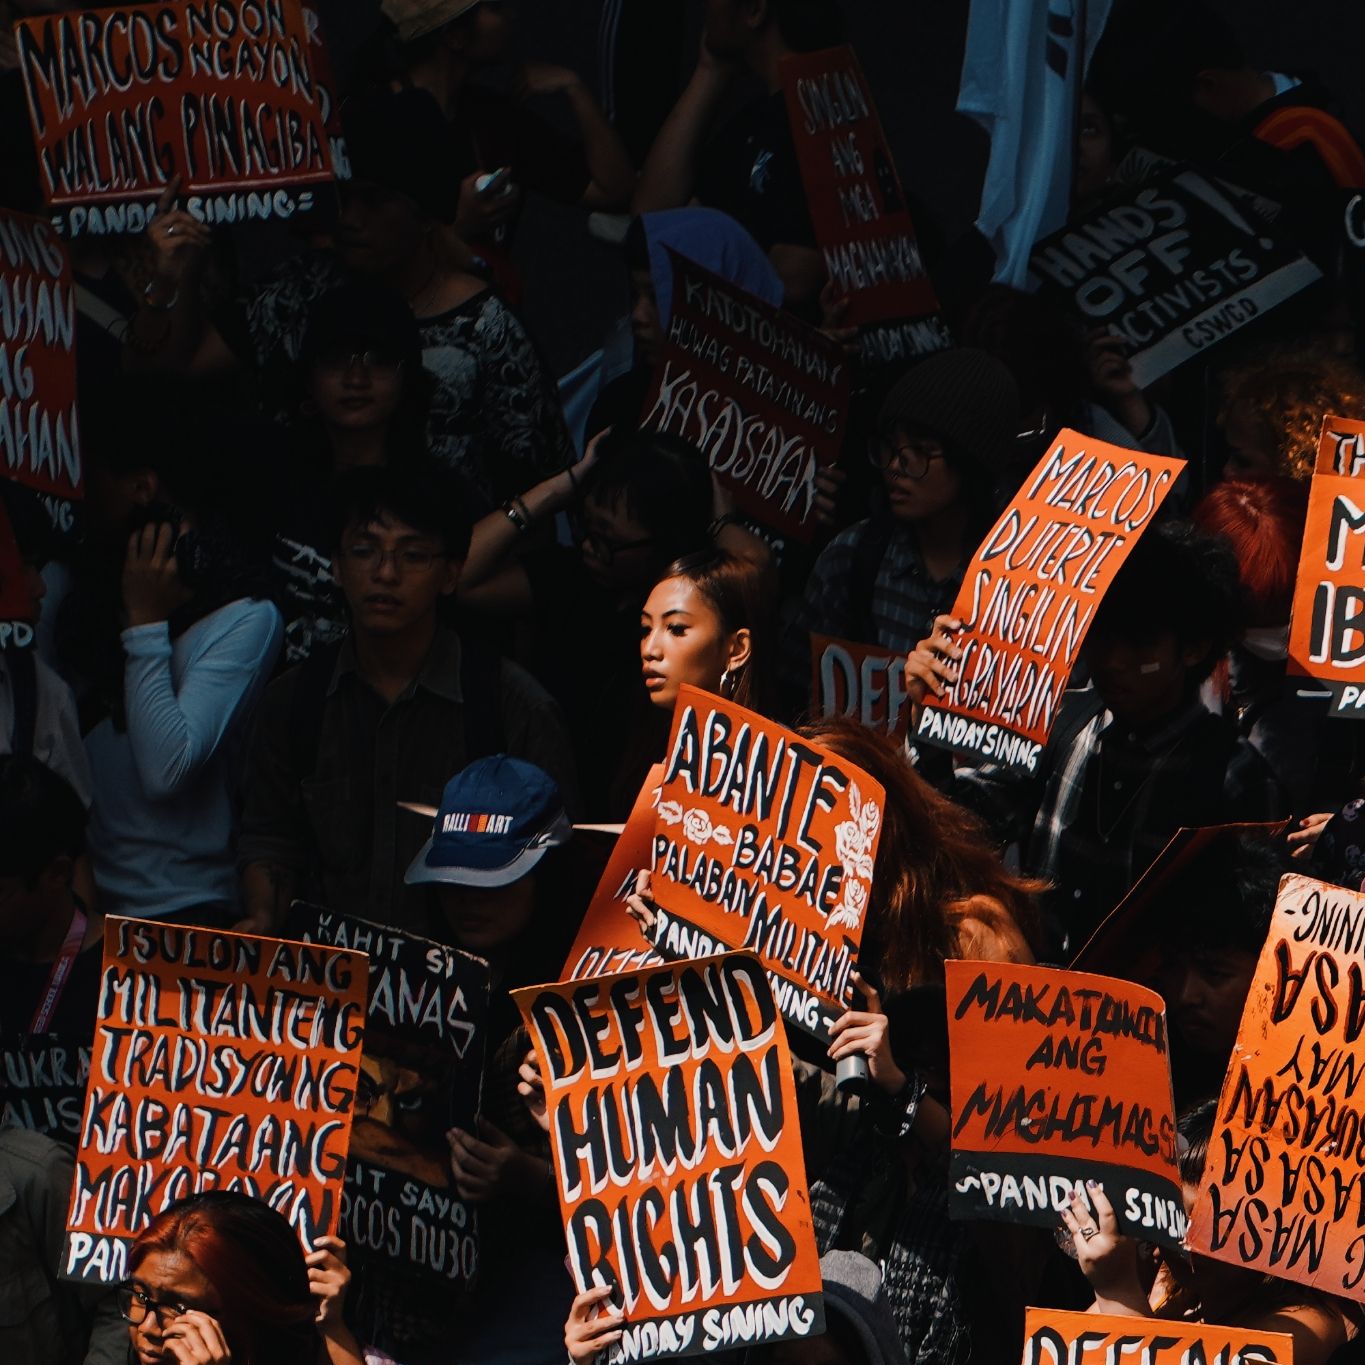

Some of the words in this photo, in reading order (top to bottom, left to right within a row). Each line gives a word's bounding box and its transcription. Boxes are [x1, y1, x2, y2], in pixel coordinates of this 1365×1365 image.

[187, 0, 286, 41] NOON
[16, 7, 184, 140] MARCOS
[188, 38, 315, 105] NGAYON
[41, 95, 177, 196] WALANG
[1032, 187, 1188, 288] HANDS
[1075, 228, 1194, 318] OFF
[1106, 247, 1260, 348] ACTIVISTS
[668, 316, 730, 373] HUWAG
[1027, 444, 1172, 533] MARCOS
[979, 507, 1127, 595] DUTERTE
[664, 704, 850, 856] ABANTE
[918, 706, 984, 748] PANDAY
[982, 724, 1044, 772] SINING
[650, 833, 764, 918] PALABAN
[732, 822, 845, 919] BABAE
[266, 941, 353, 993] ANG
[318, 912, 406, 964] KAHIT
[425, 947, 457, 981] SI
[97, 964, 366, 1054] MILITANTENG
[530, 954, 776, 1092] DEFEND
[294, 1052, 362, 1115] NG
[1025, 1036, 1107, 1076] ANG
[82, 1085, 347, 1185] KABATAANG
[555, 1044, 786, 1204] HUMAN
[1221, 1129, 1274, 1194] SA
[70, 1161, 334, 1255] MAKAAN
[400, 1183, 467, 1228] SAYO
[566, 1159, 797, 1321] RIGHTS
[1209, 1180, 1329, 1275] MASA
[701, 1295, 816, 1352] SINING
